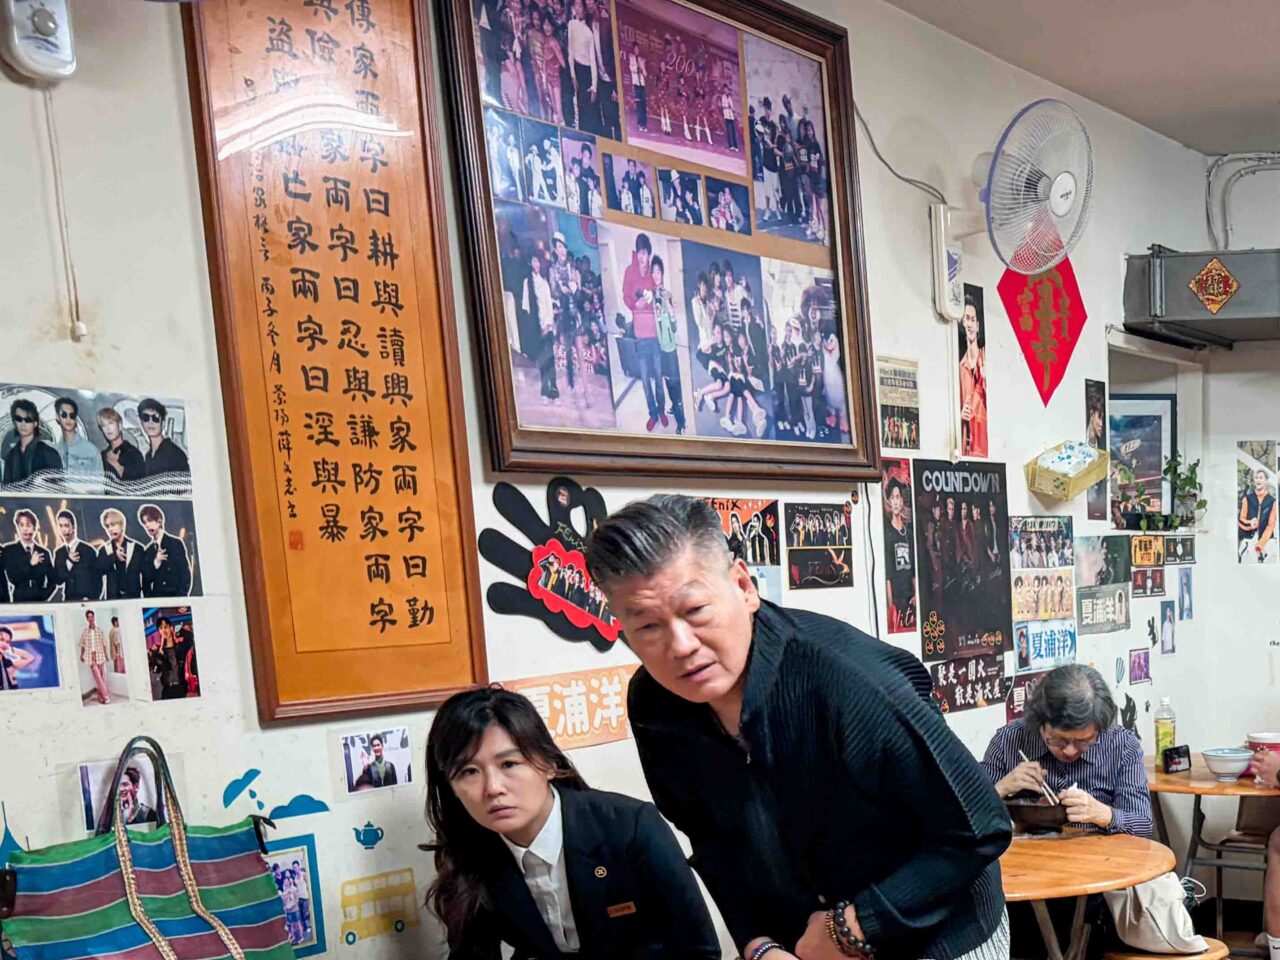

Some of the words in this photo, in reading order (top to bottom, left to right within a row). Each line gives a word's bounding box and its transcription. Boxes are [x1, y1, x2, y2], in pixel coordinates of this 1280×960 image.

[922, 470, 1000, 493] COUNTDOWN
[710, 498, 742, 511] EniX
[1081, 597, 1117, 626] 夏浦洋
[1031, 627, 1070, 661] 夏浦洋
